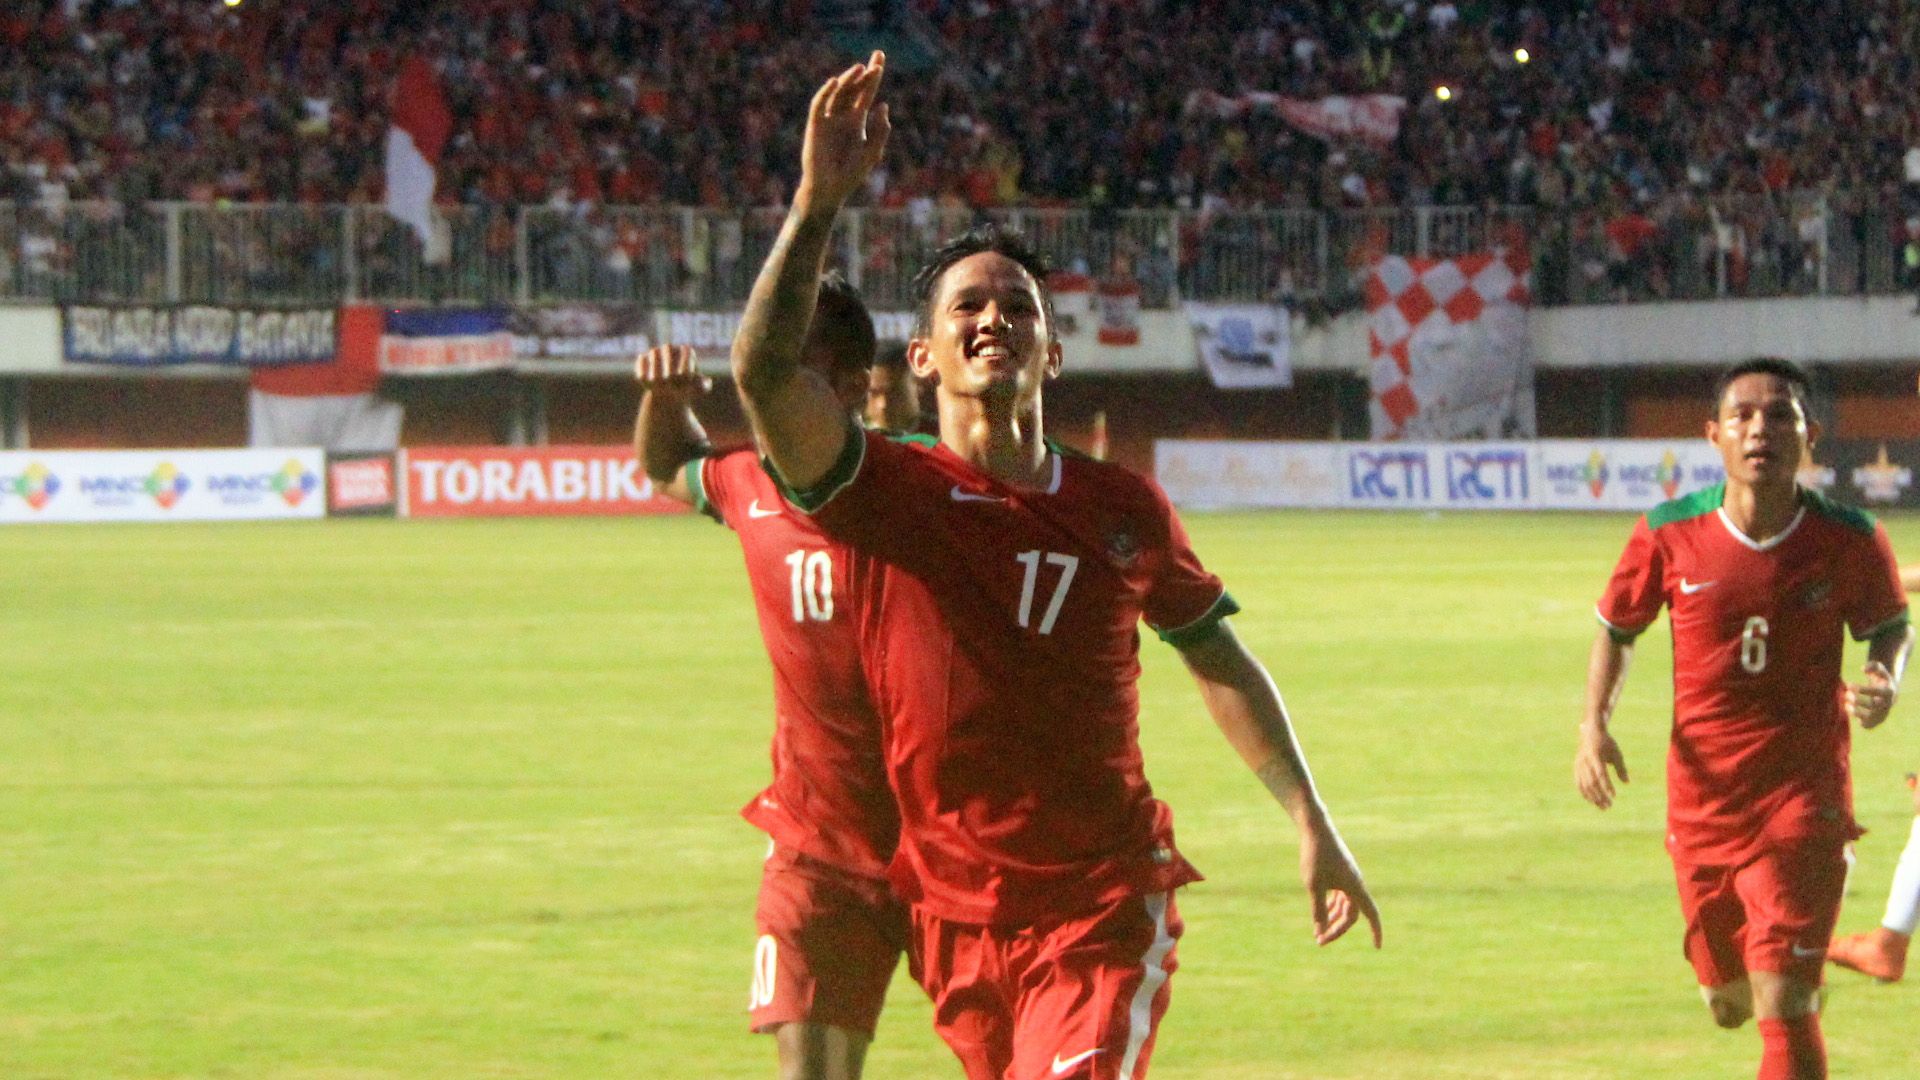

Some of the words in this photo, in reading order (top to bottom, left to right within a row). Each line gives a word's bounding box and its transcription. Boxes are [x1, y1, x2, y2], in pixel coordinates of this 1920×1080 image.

[785, 548, 834, 622] 10
[1015, 549, 1080, 636] 17
[1740, 616, 1769, 674] 6
